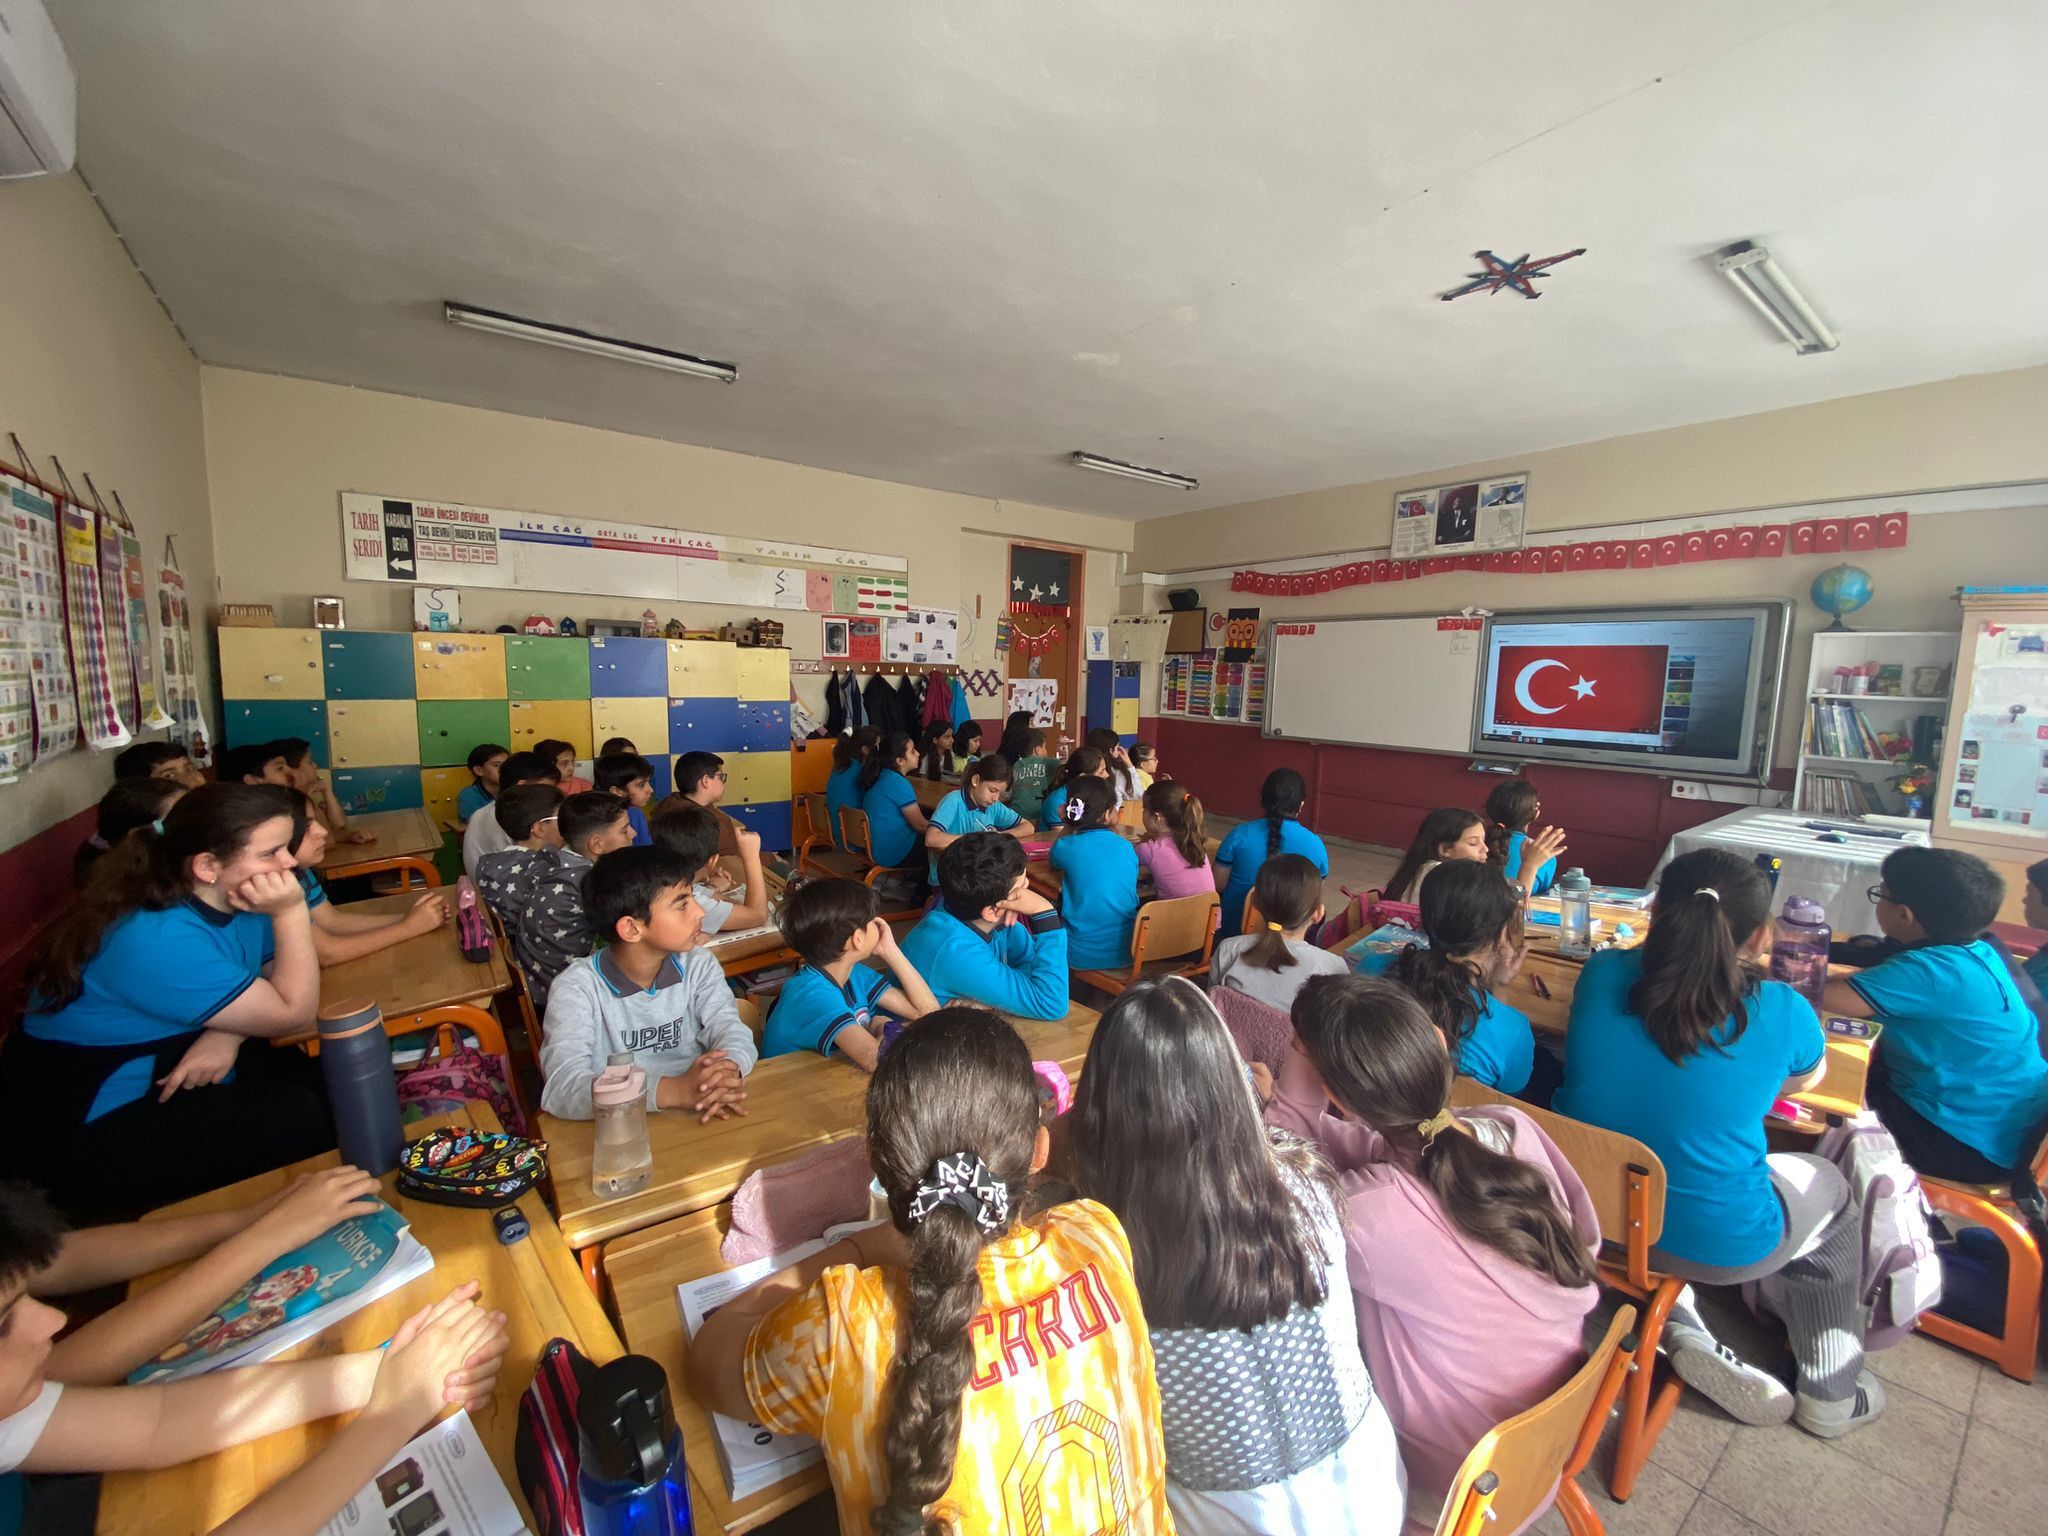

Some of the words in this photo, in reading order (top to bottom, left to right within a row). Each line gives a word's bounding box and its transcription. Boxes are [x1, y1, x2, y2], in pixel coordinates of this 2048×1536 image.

[351, 508, 379, 531] TARİH
[418, 525, 429, 538] TAŞ
[597, 530, 618, 538] ORTA
[652, 535, 682, 545] YENİ
[352, 535, 383, 561] ŞERİDİ
[755, 547, 811, 559] YAKIN
[333, 1220, 382, 1269] TÜRKÇE
[316, 1267, 352, 1296] 4
[968, 1262, 1121, 1392] CARDI
